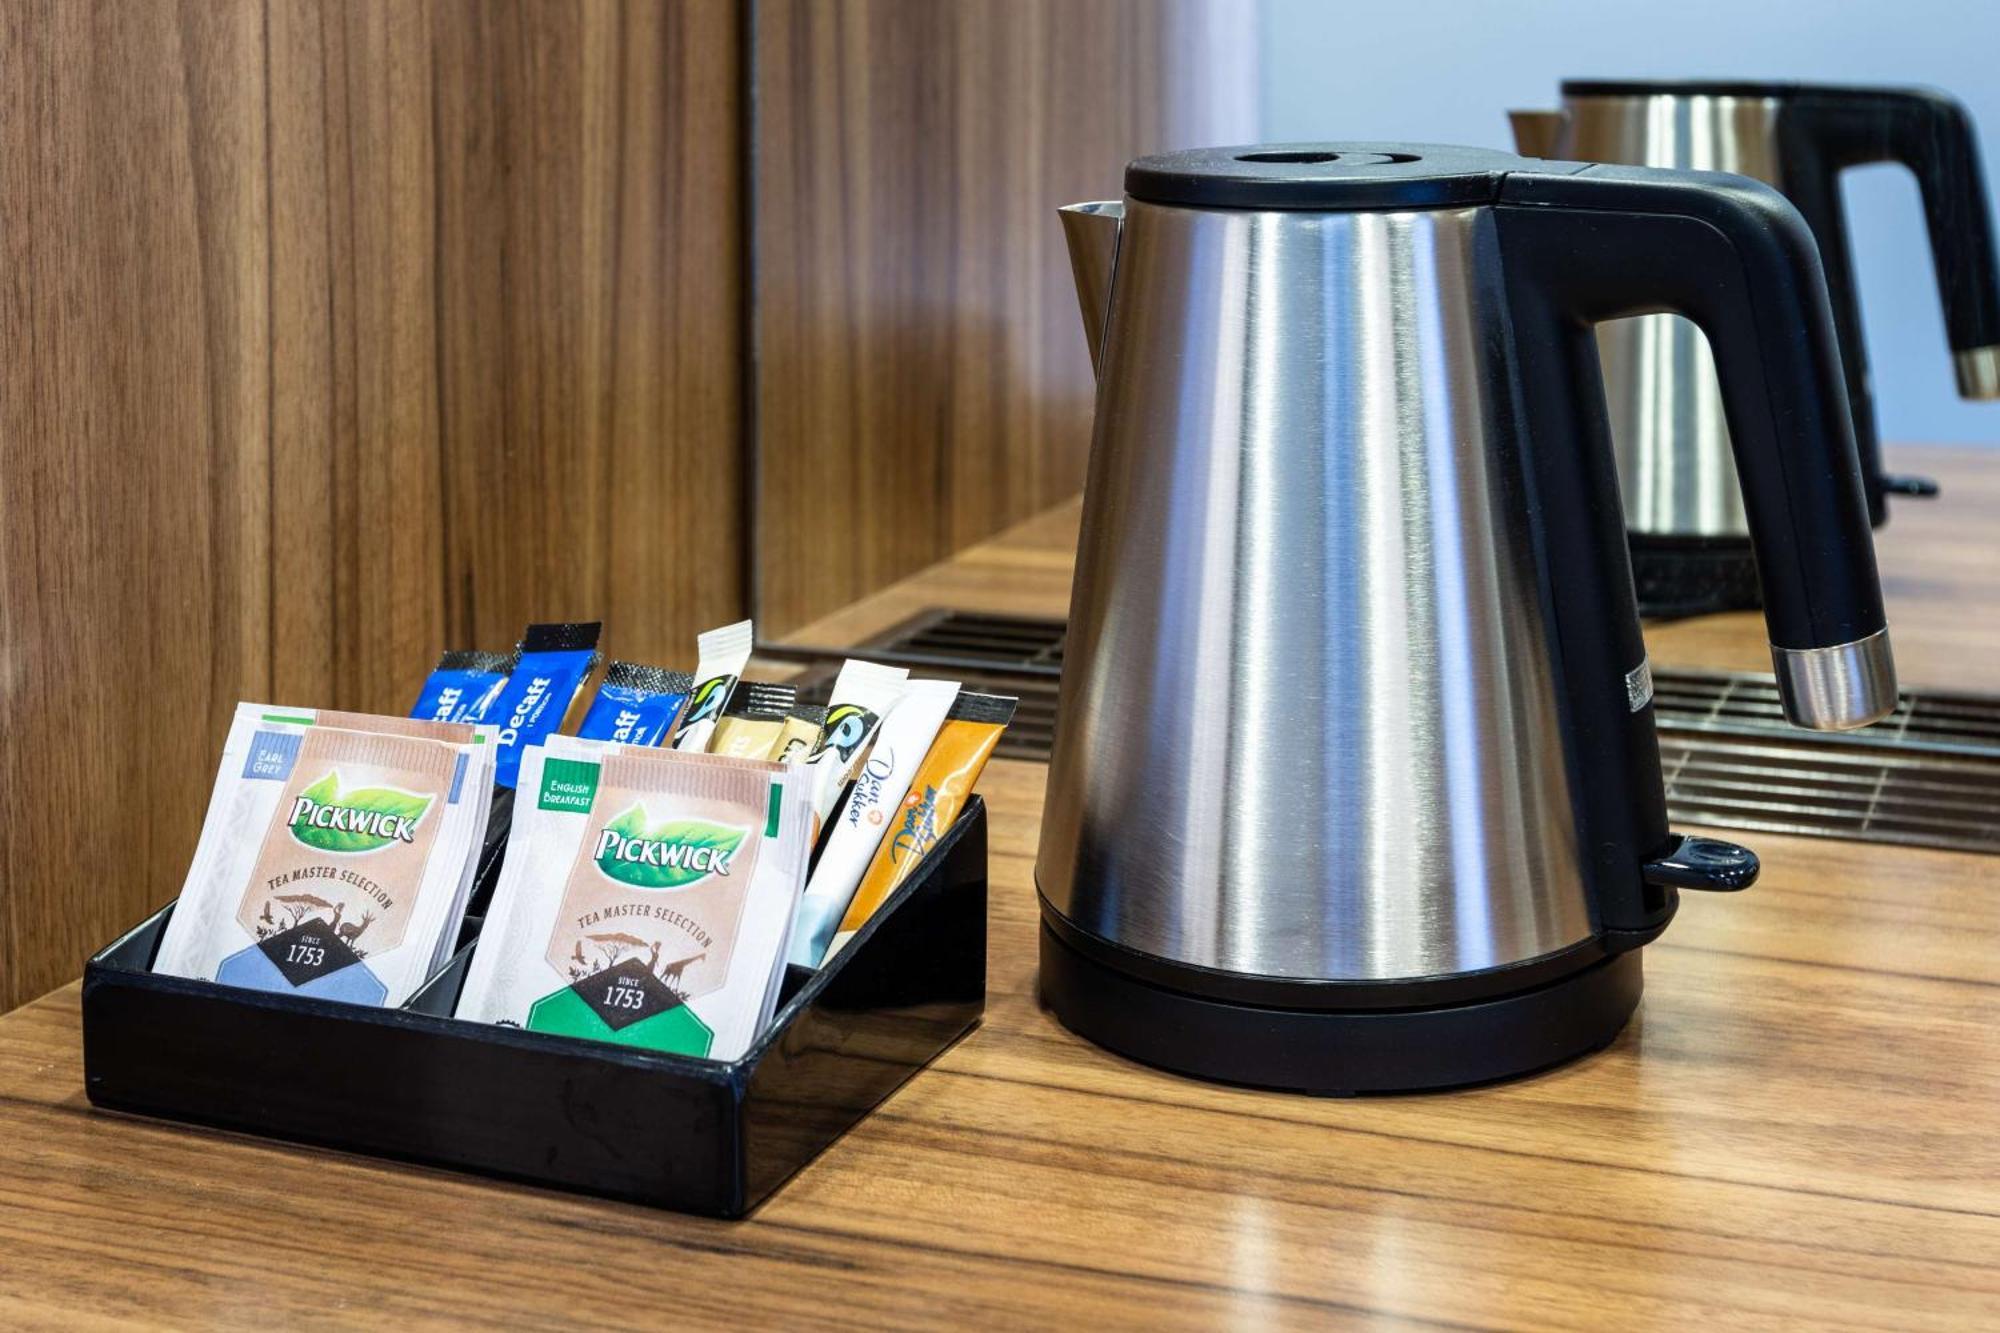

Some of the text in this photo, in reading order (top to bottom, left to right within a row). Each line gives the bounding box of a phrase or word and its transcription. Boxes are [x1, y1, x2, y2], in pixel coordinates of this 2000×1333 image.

[499, 677, 551, 747] Decaff
[551, 780, 589, 794] ENGLISH
[866, 747, 895, 804] Dan
[287, 796, 414, 843] PICKWICK
[543, 791, 591, 806] BREAKFAST
[849, 772, 869, 828] Cukker
[594, 828, 731, 876] PICKWICK
[267, 866, 393, 910] TEA MASTER SELECTION
[577, 904, 713, 948] TEA MASTER SELECTION
[286, 944, 325, 966] 1753
[603, 985, 645, 1010] 1753
[617, 976, 639, 987] SINCE
